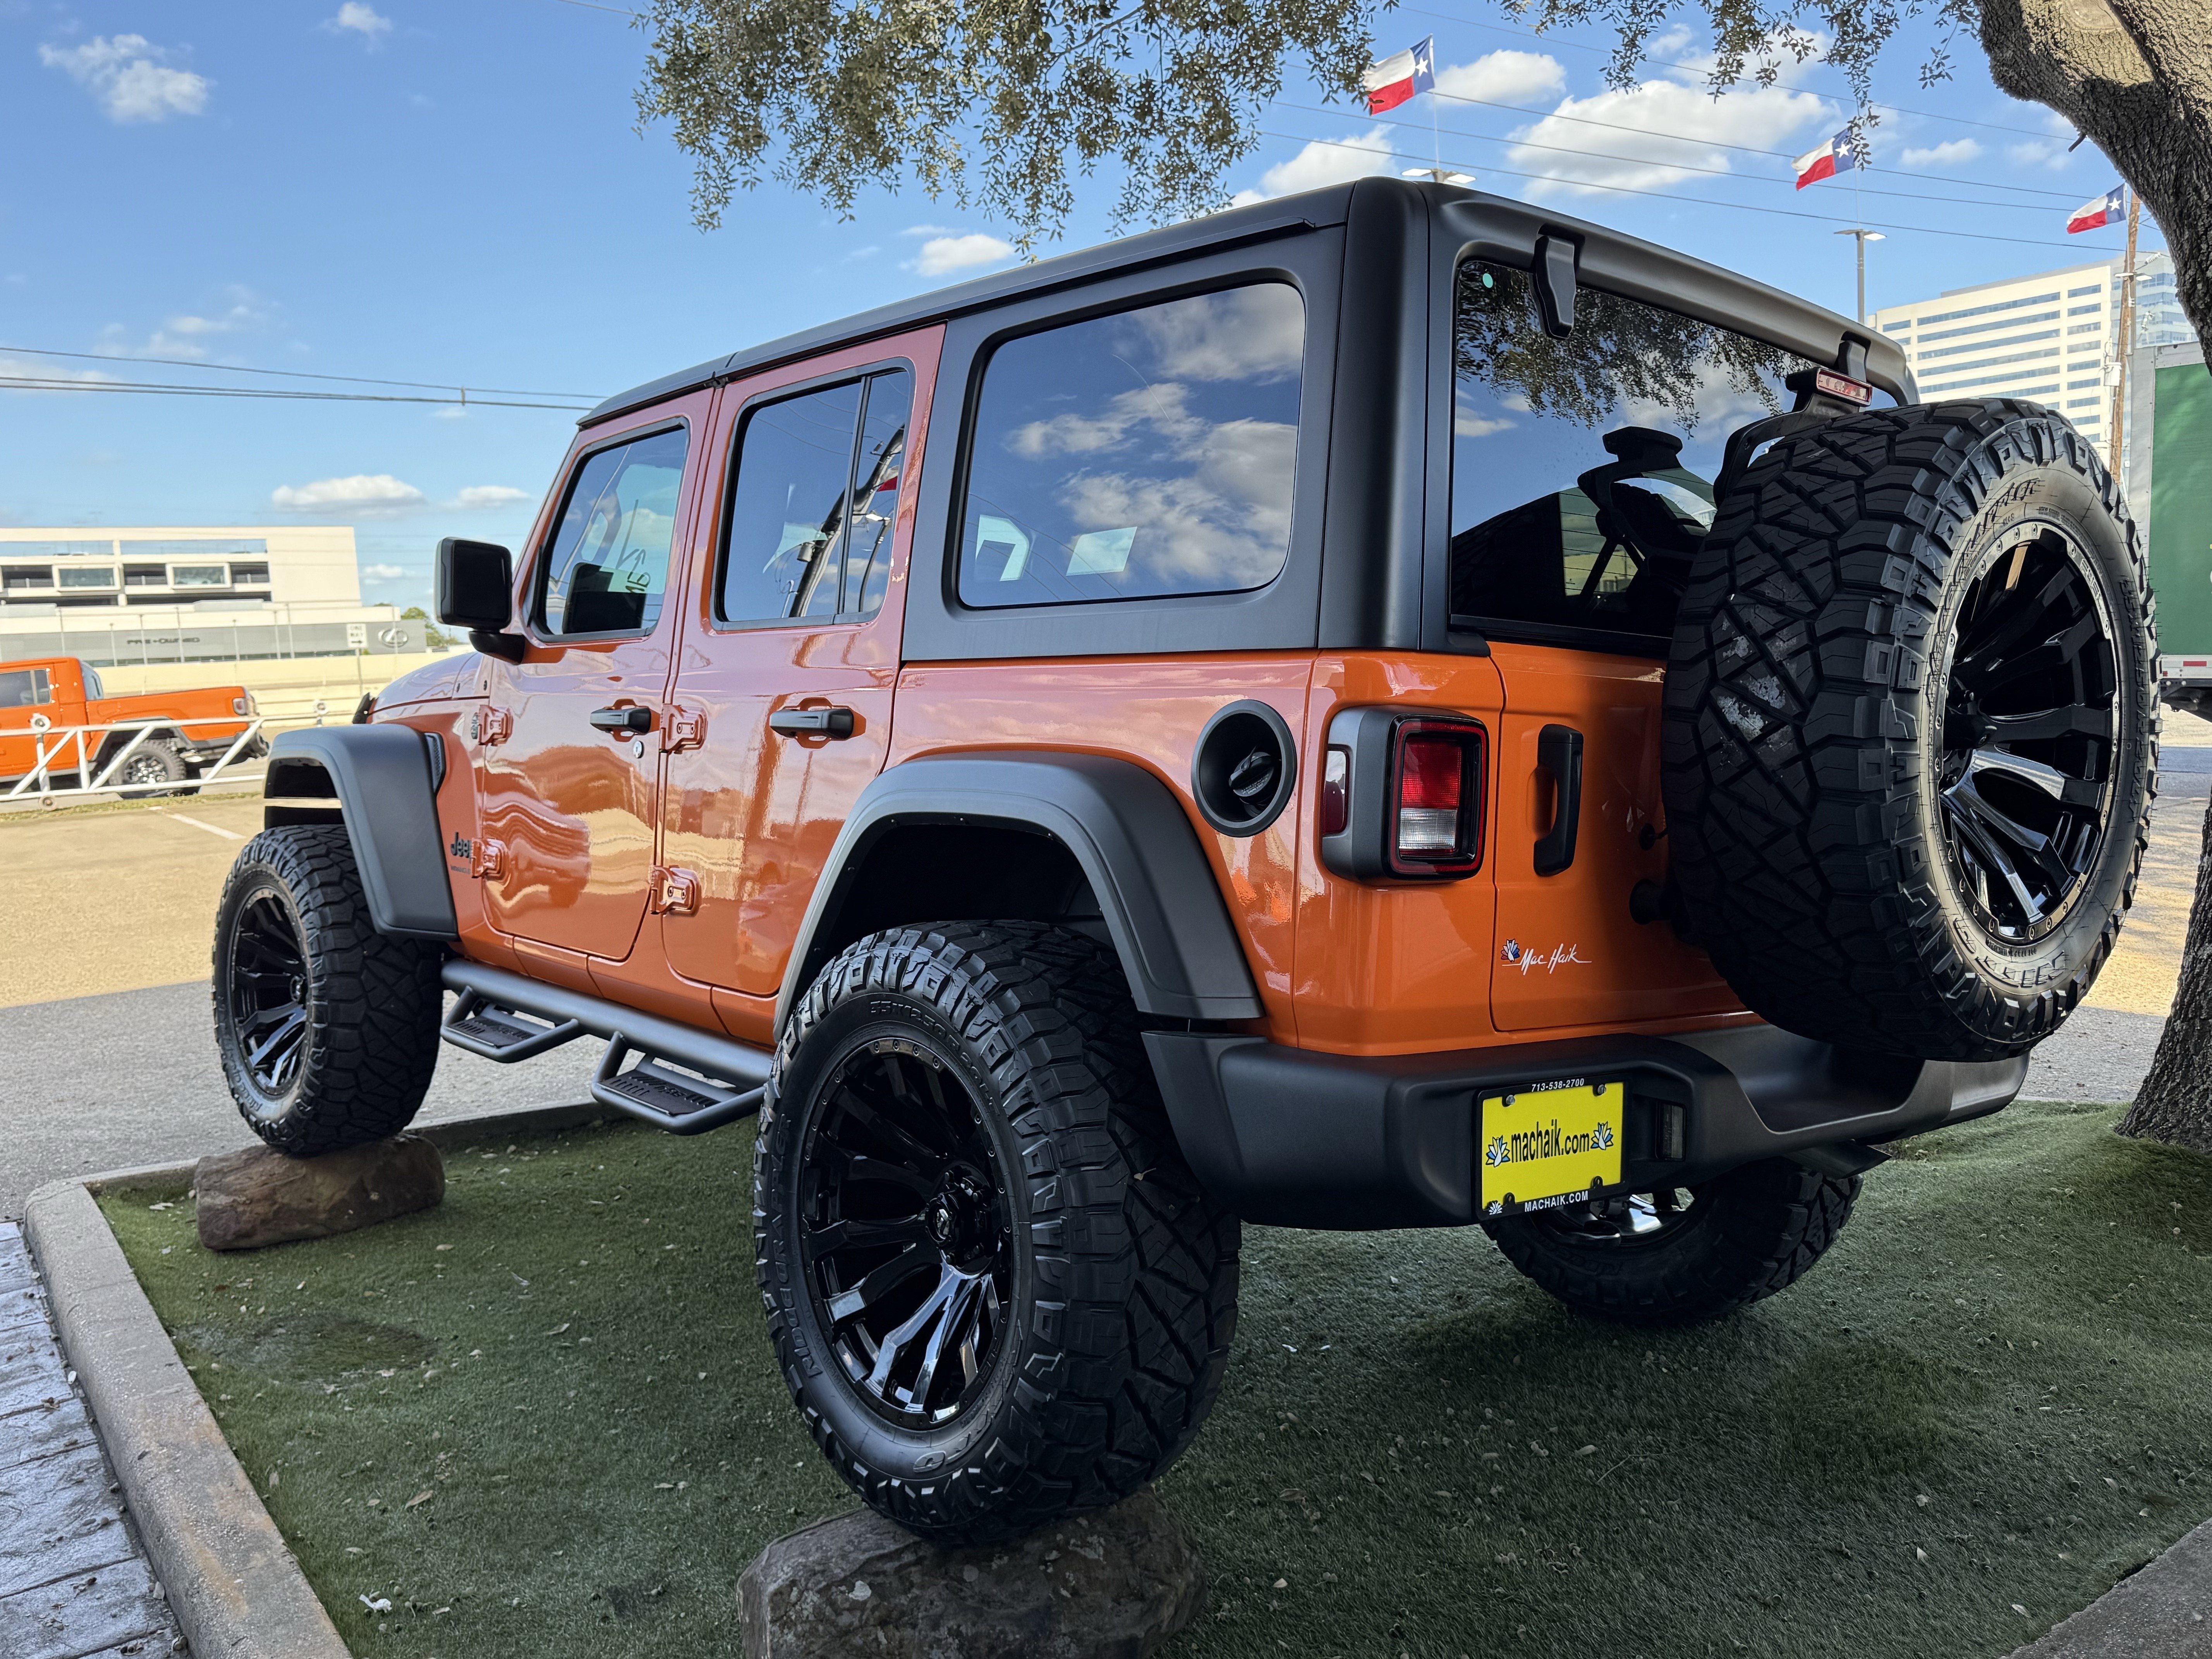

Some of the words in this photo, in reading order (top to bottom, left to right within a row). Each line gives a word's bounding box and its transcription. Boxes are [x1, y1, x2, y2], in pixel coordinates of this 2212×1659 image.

[2080, 558, 2102, 609] FUEL
[450, 832, 471, 863] Jee
[1502, 948, 1547, 975] Mac
[1547, 943, 1592, 974] Haik
[1532, 1078, 1584, 1092] 713-538-2700
[1511, 1118, 1590, 1163] machaik.com
[1524, 1190, 1588, 1212] MACHAIK.COM
